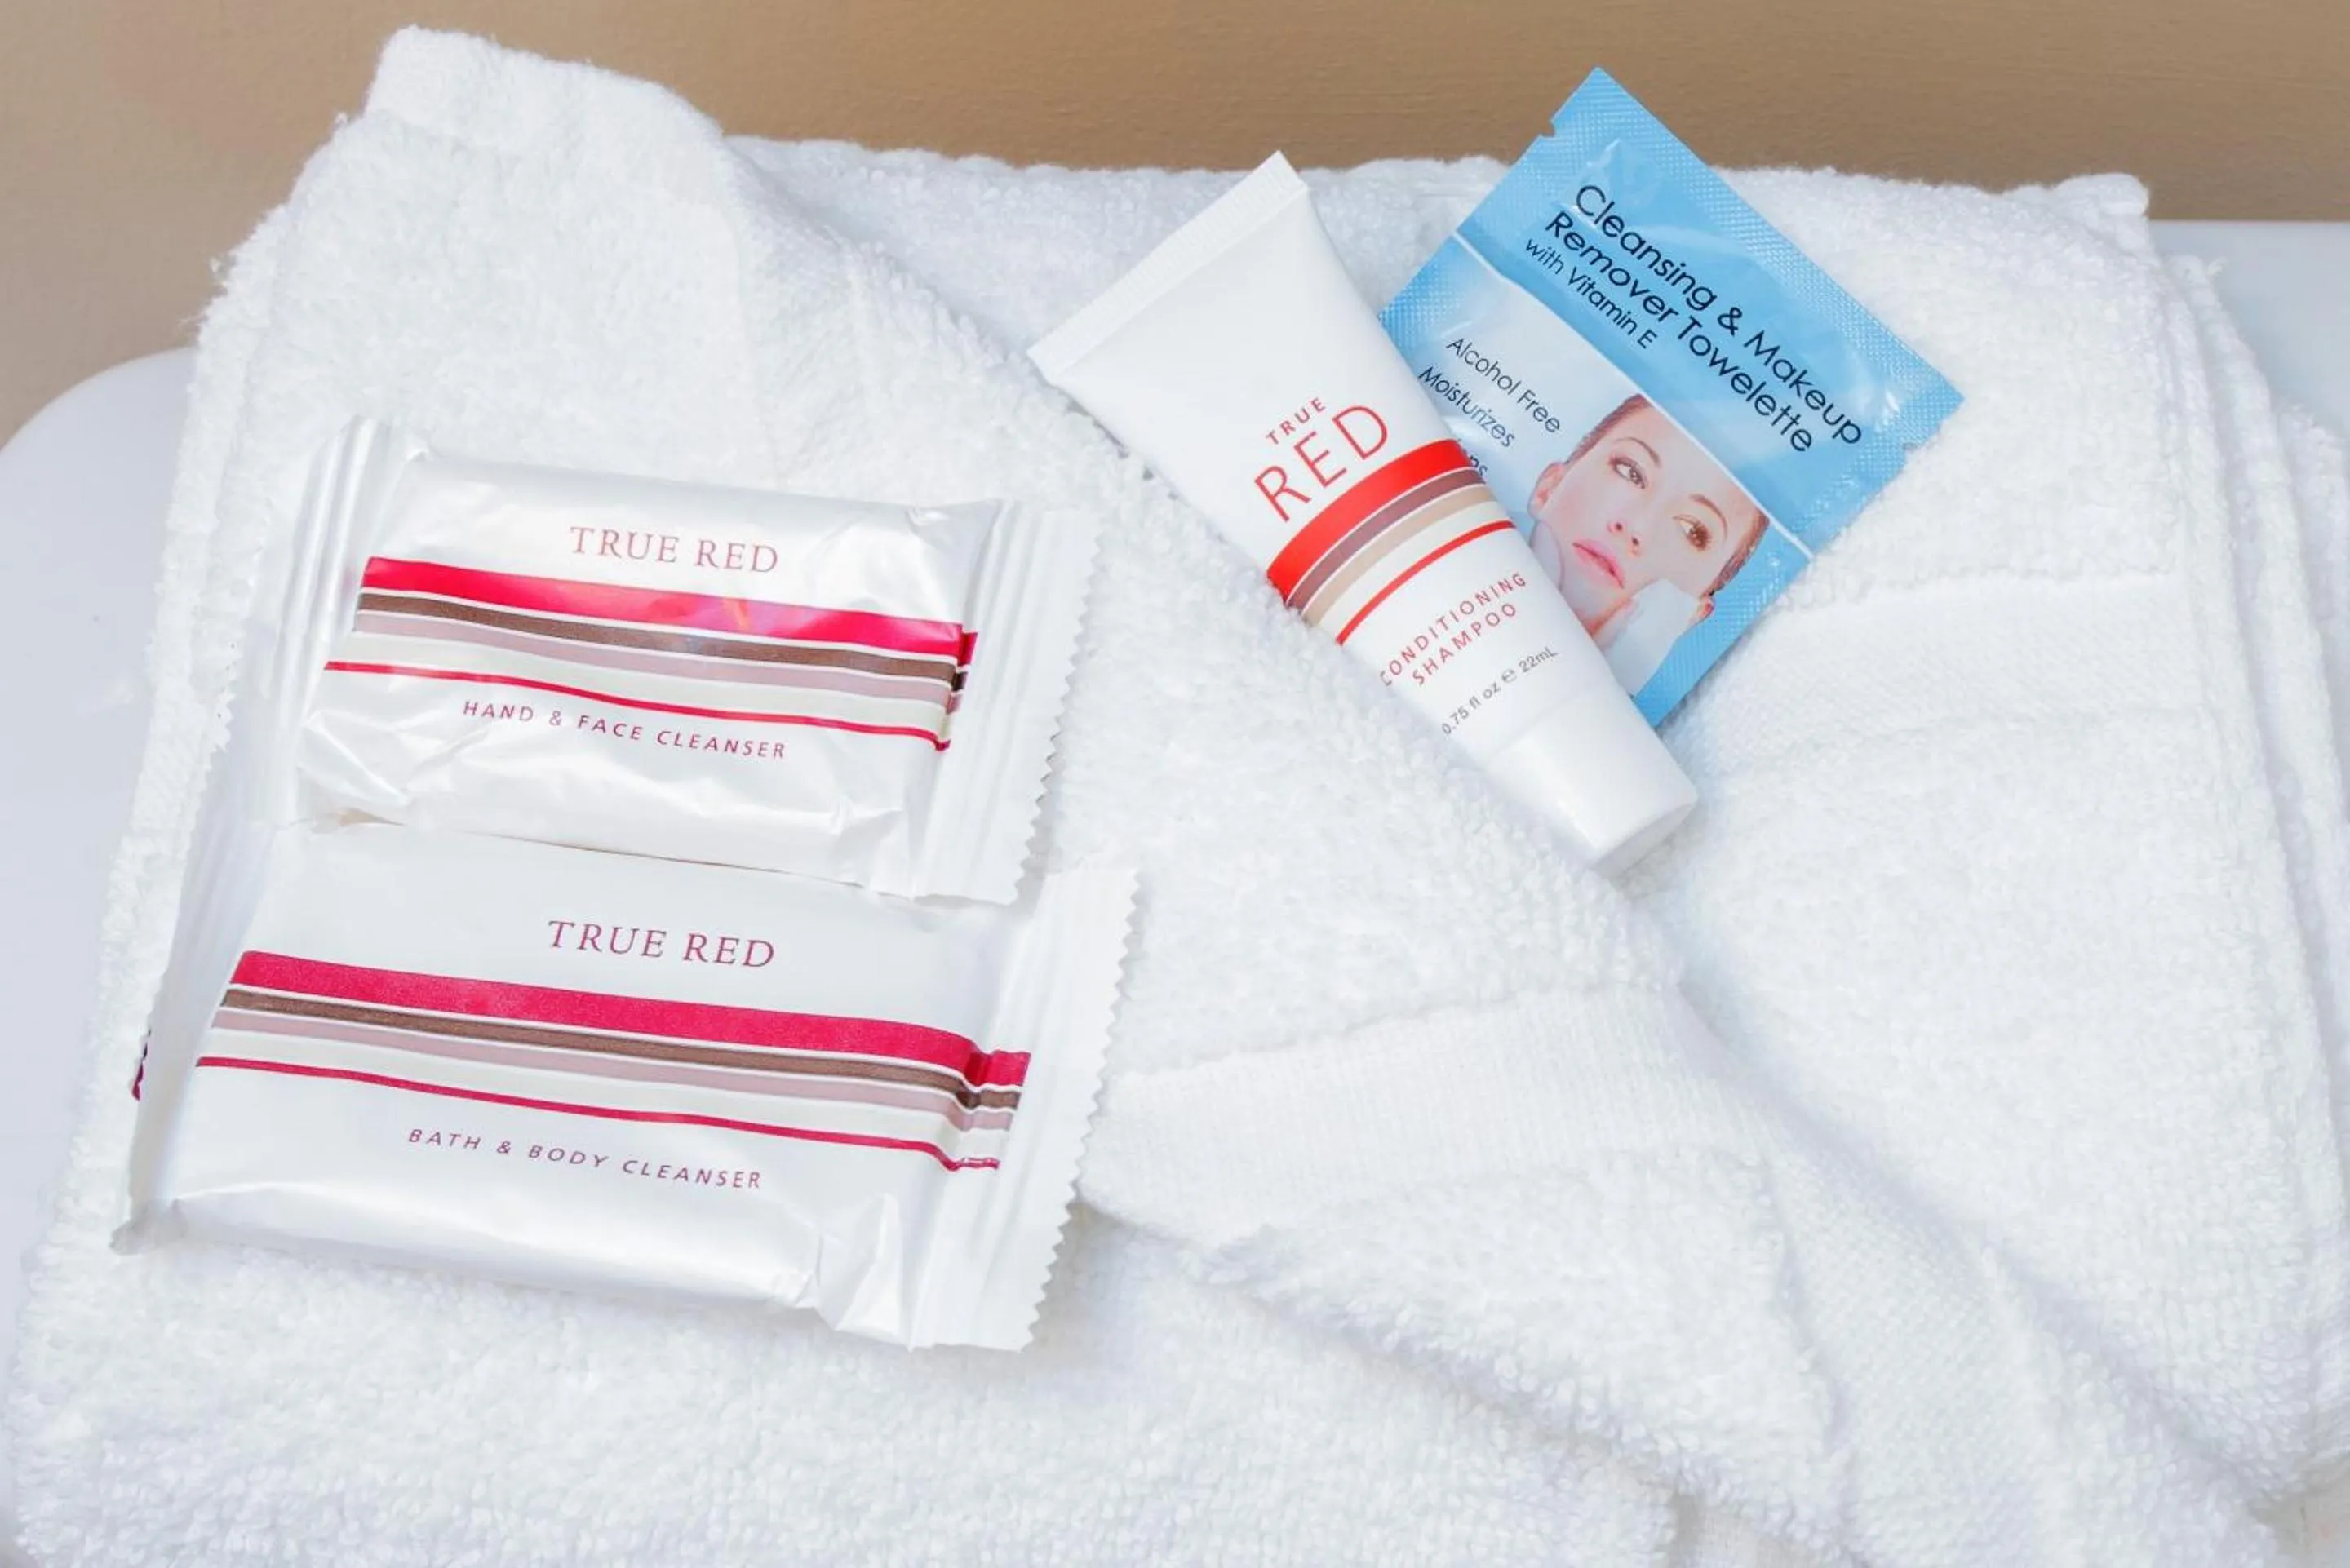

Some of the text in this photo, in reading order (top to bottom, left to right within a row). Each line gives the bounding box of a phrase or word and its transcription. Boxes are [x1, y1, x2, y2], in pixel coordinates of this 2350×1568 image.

[1525, 238, 1658, 349] with Vitamin E
[1545, 211, 1812, 452] Remover Towelette
[1576, 184, 1862, 444] Cleansing & Makeup
[1265, 397, 1326, 445] TRUE
[1417, 366, 1515, 448] Moisturizes
[1446, 335, 1560, 433] Alcohol Free
[1253, 405, 1388, 522] RED
[570, 526, 778, 573] TRUE RED
[1379, 573, 1527, 687] CONDITIONING
[1412, 603, 1516, 686] SHAMPOO
[463, 701, 786, 759] HAND & FACE CLEANSER
[1442, 706, 1470, 735] 0.75
[1469, 695, 1483, 710] fl
[1483, 681, 1501, 699] oz
[1519, 646, 1559, 673] 22mL
[548, 920, 774, 968] TRUE RED
[408, 1129, 761, 1189] BATH & BODY CLEANSER
